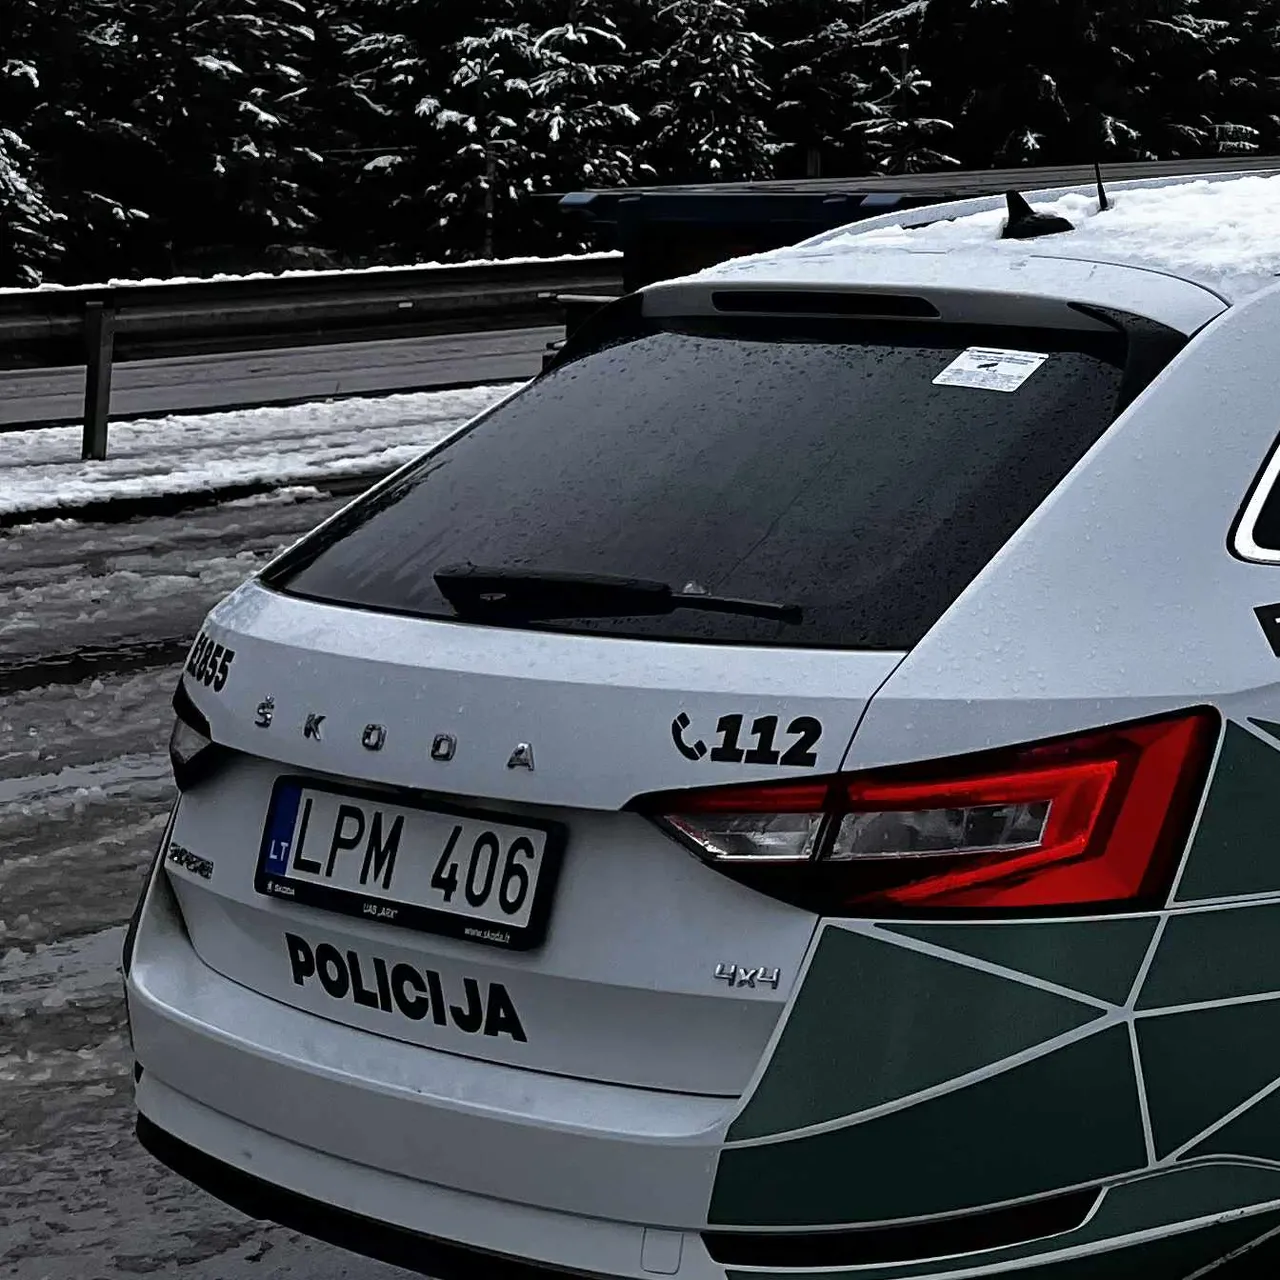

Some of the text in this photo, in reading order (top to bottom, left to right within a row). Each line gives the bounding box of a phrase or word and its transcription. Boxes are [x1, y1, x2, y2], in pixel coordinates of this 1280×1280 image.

[254, 693, 535, 772] ŠKODA
[710, 713, 823, 768] 112
[269, 839, 289, 862] LT
[293, 798, 405, 890] LPM
[431, 825, 535, 916] 406
[284, 931, 528, 1043] POLICIJA
[714, 963, 781, 990] 4x4
